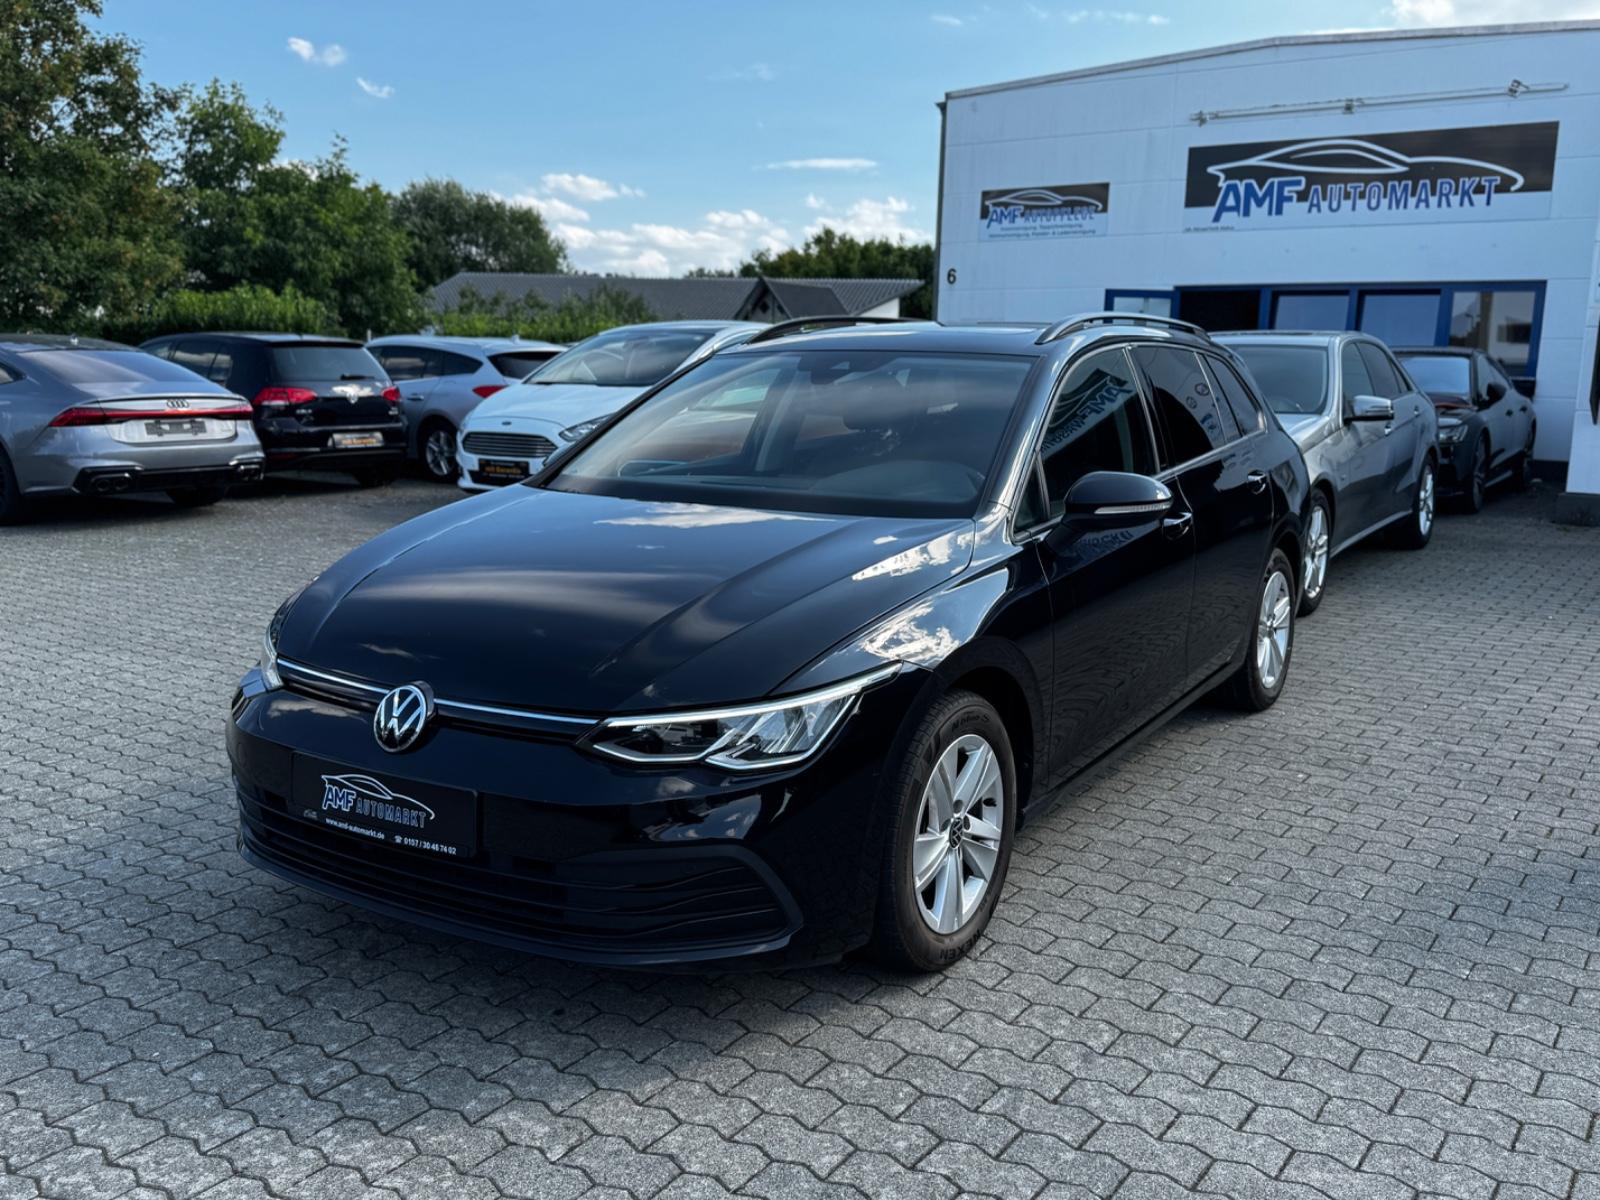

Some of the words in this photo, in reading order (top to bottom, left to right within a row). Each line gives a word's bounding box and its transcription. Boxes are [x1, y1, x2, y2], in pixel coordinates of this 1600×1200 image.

[1212, 176, 1306, 223] AMF
[1307, 176, 1501, 213] AUTOMARKT
[986, 205, 1024, 229] AMF
[946, 268, 957, 285] 6
[322, 785, 357, 812] AMF
[355, 797, 427, 829] AUTOMARKT
[940, 929, 981, 960] NEXEN
